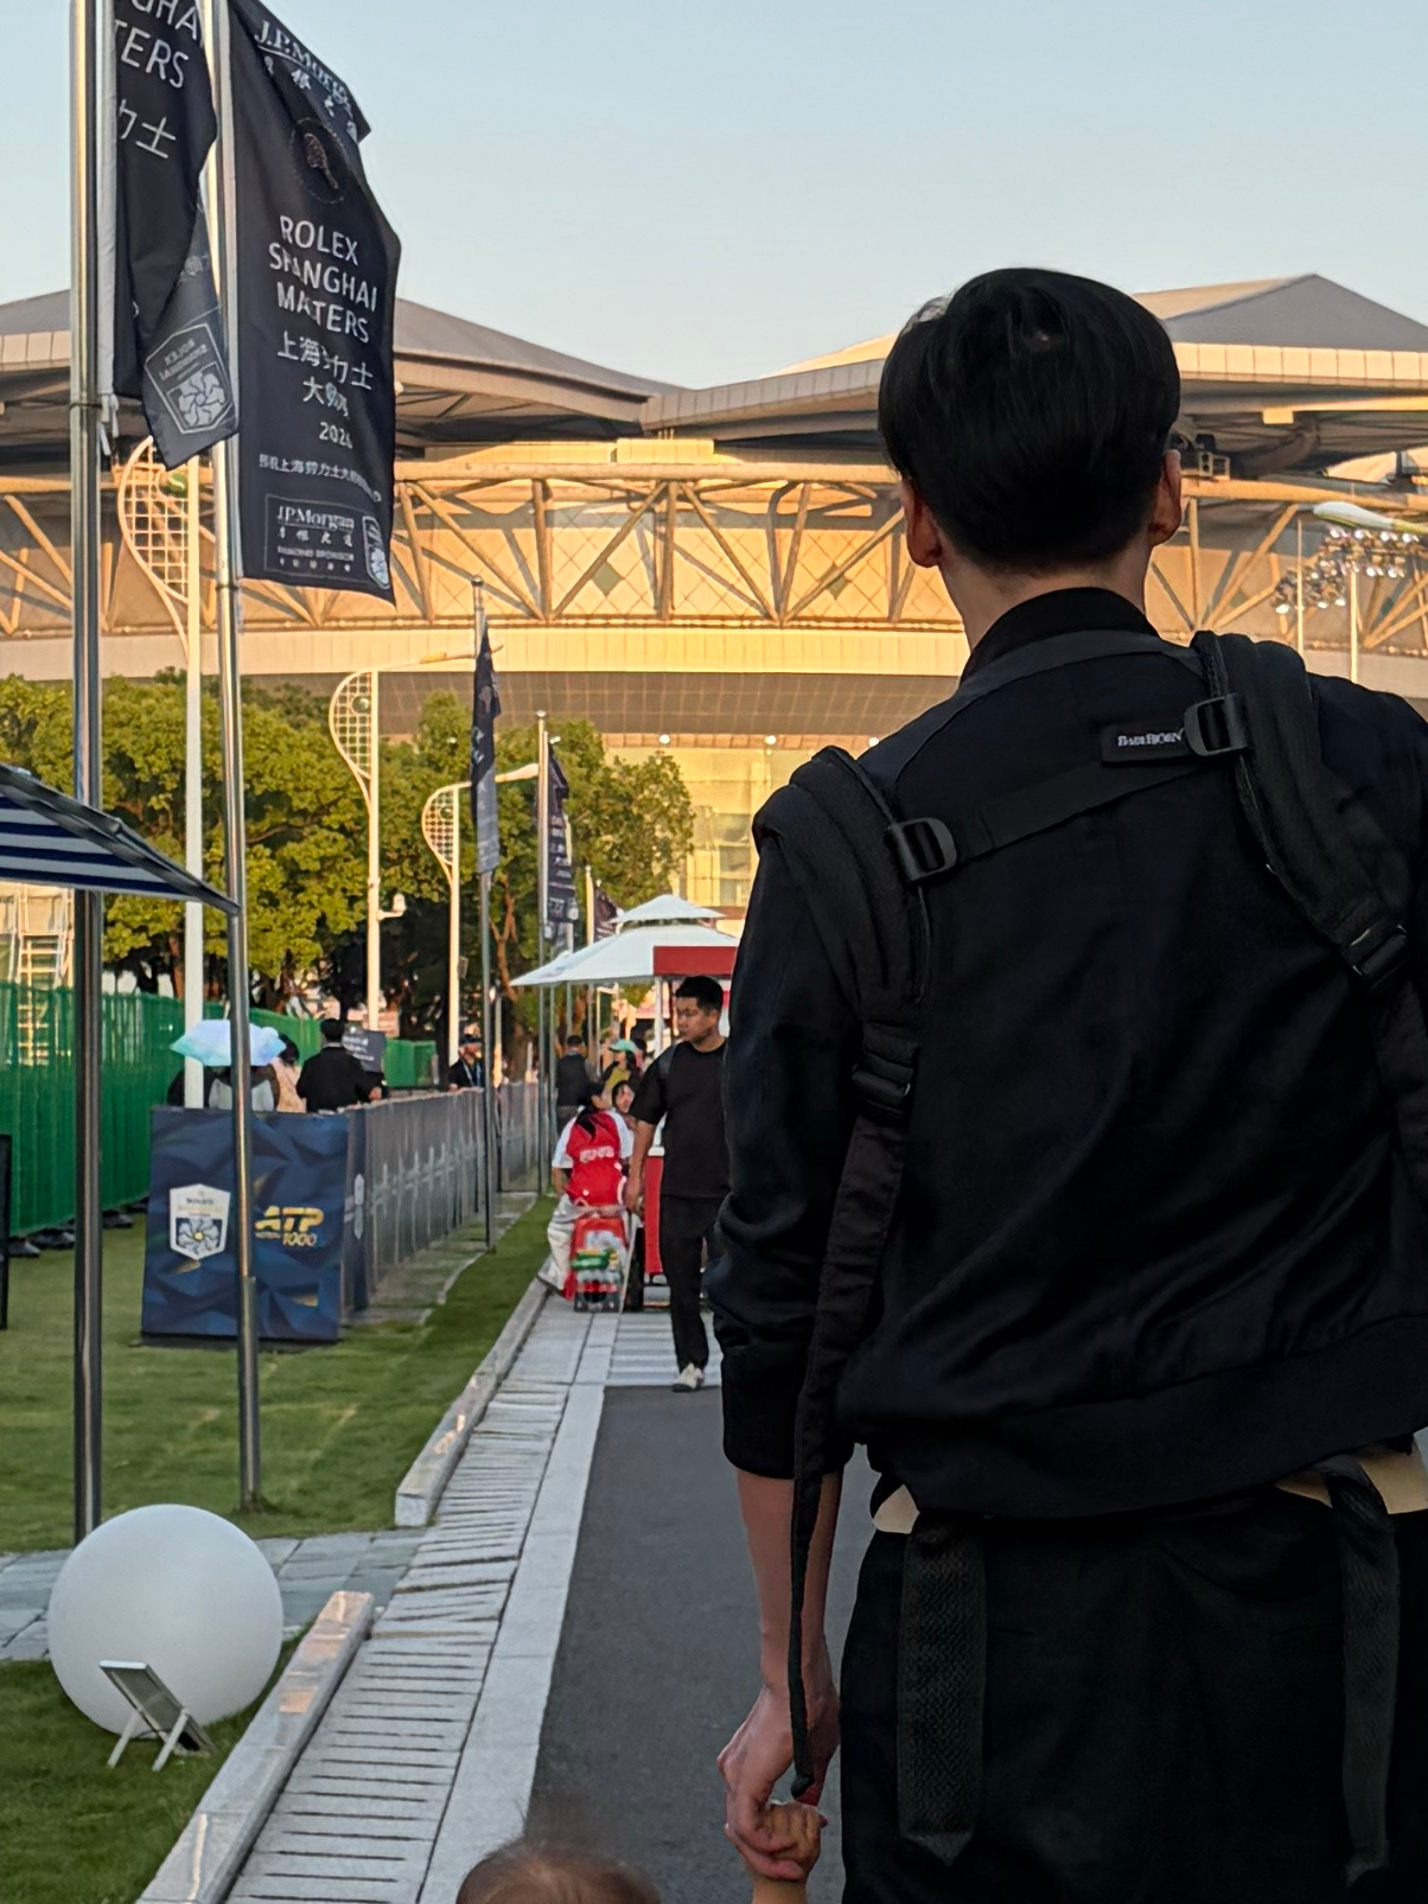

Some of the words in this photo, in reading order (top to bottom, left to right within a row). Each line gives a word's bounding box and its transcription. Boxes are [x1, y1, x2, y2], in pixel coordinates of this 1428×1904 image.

[280, 215, 358, 266] ROLEX
[255, 1206, 325, 1233] ATP
[283, 1231, 317, 1246] 1000
